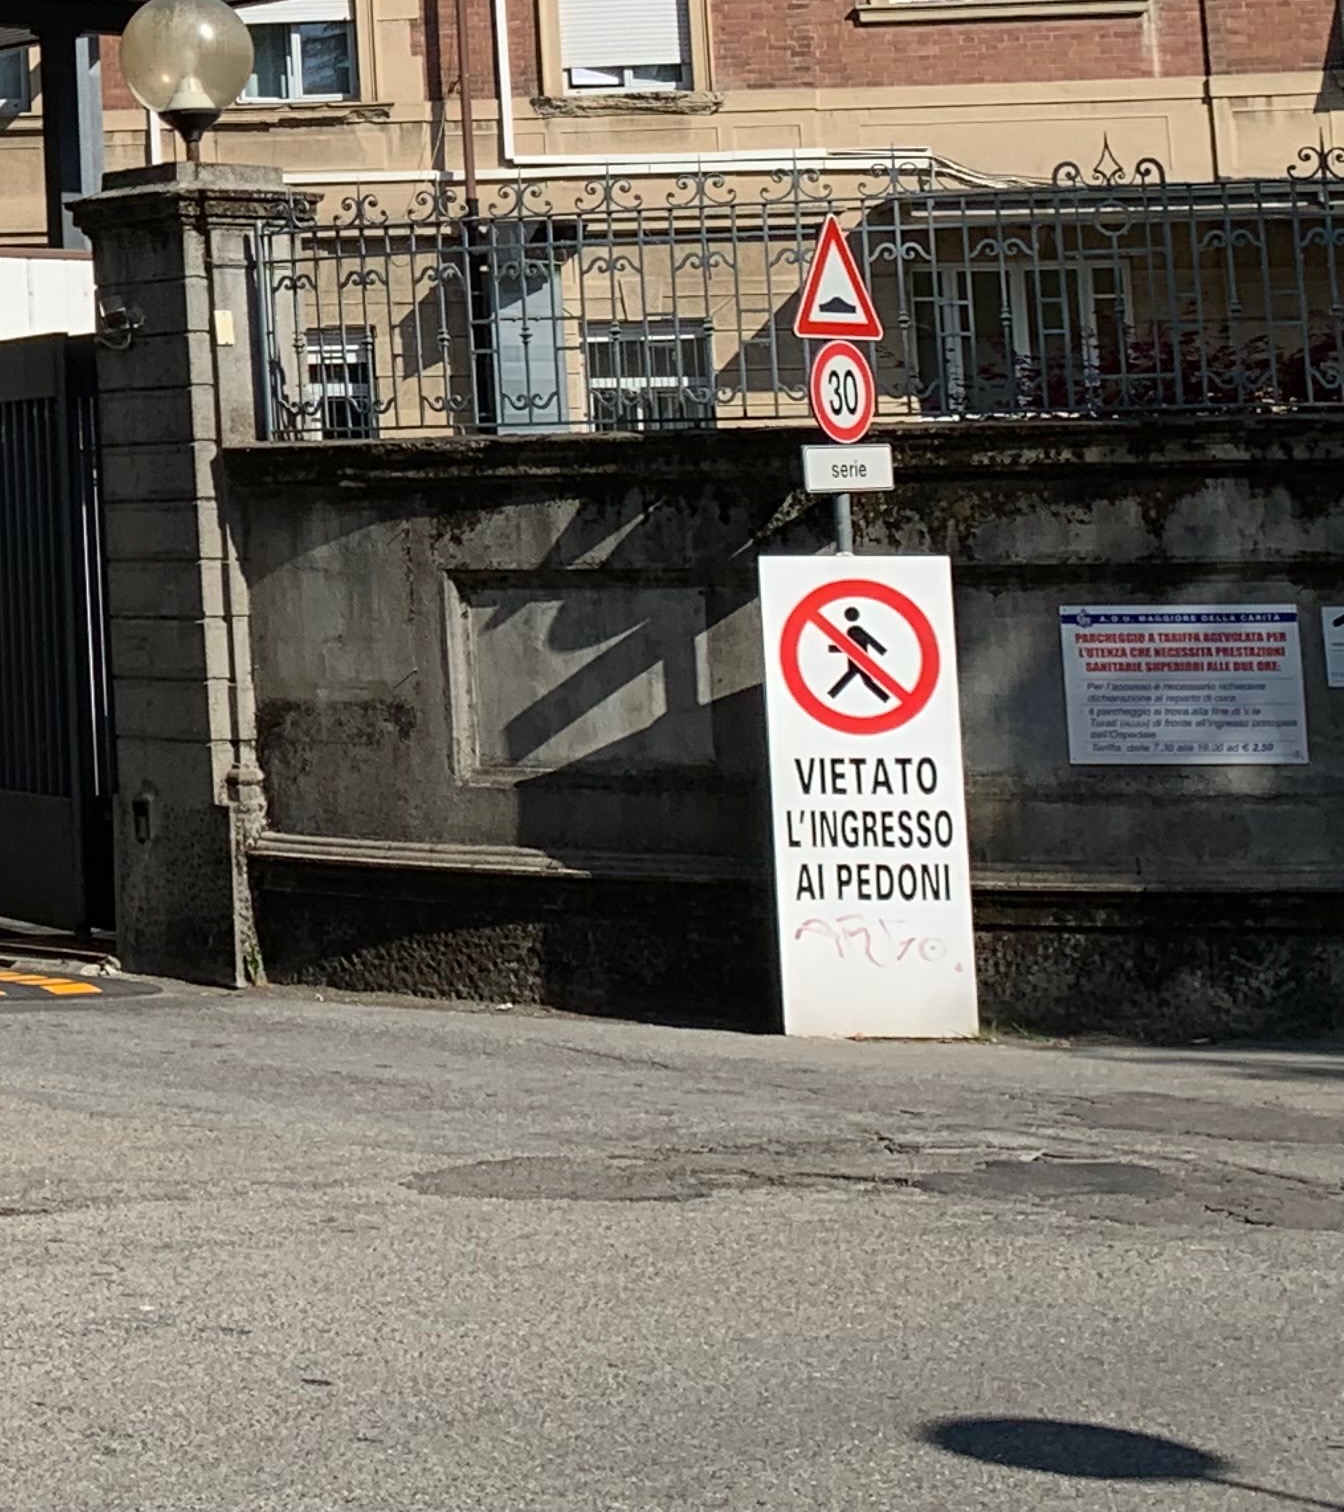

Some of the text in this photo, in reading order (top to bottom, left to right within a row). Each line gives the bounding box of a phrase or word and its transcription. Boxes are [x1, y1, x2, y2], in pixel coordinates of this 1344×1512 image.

[828, 370, 858, 416] 30
[831, 459, 867, 478] serie
[1138, 614, 1197, 622] MAGGIORE
[1201, 614, 1236, 622] DELLA
[1074, 633, 1146, 643] PARCHEGGIO
[1266, 632, 1287, 642] PER
[1130, 647, 1152, 657] CHE
[1154, 647, 1213, 657] NECESSITA
[1215, 647, 1285, 657] PRESTAZIONI
[1207, 662, 1231, 672] ALLE
[1233, 662, 1254, 672] DUE
[794, 757, 938, 795] VIETATO
[786, 810, 953, 848] L'INGRESSO
[796, 864, 951, 902] AI PEDONI
